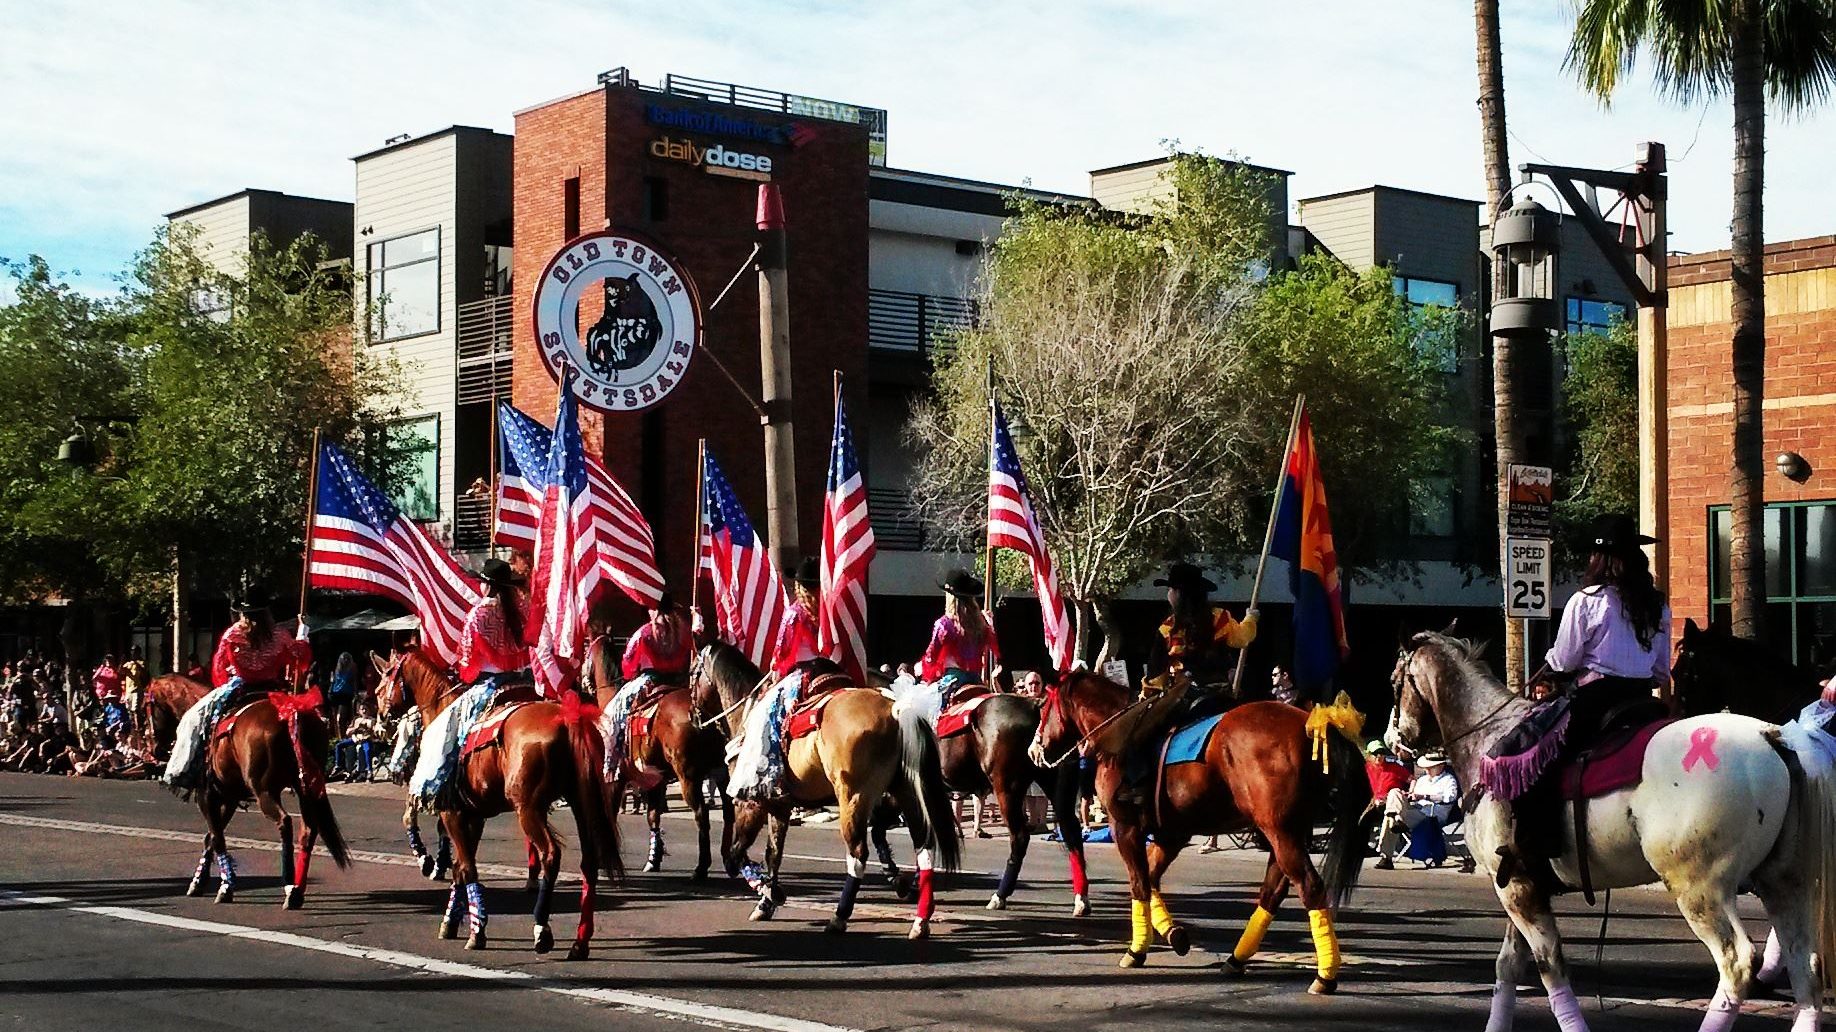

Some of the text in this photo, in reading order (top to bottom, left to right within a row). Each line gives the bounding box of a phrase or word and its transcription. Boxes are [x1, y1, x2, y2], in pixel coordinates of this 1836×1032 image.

[553, 240, 682, 296] OLD TOWN
[543, 331, 690, 407] SCOTTSDALE
[1512, 546, 1545, 560] SPEED
[1516, 562, 1541, 575] LIMIT
[1512, 580, 1545, 609] 25
